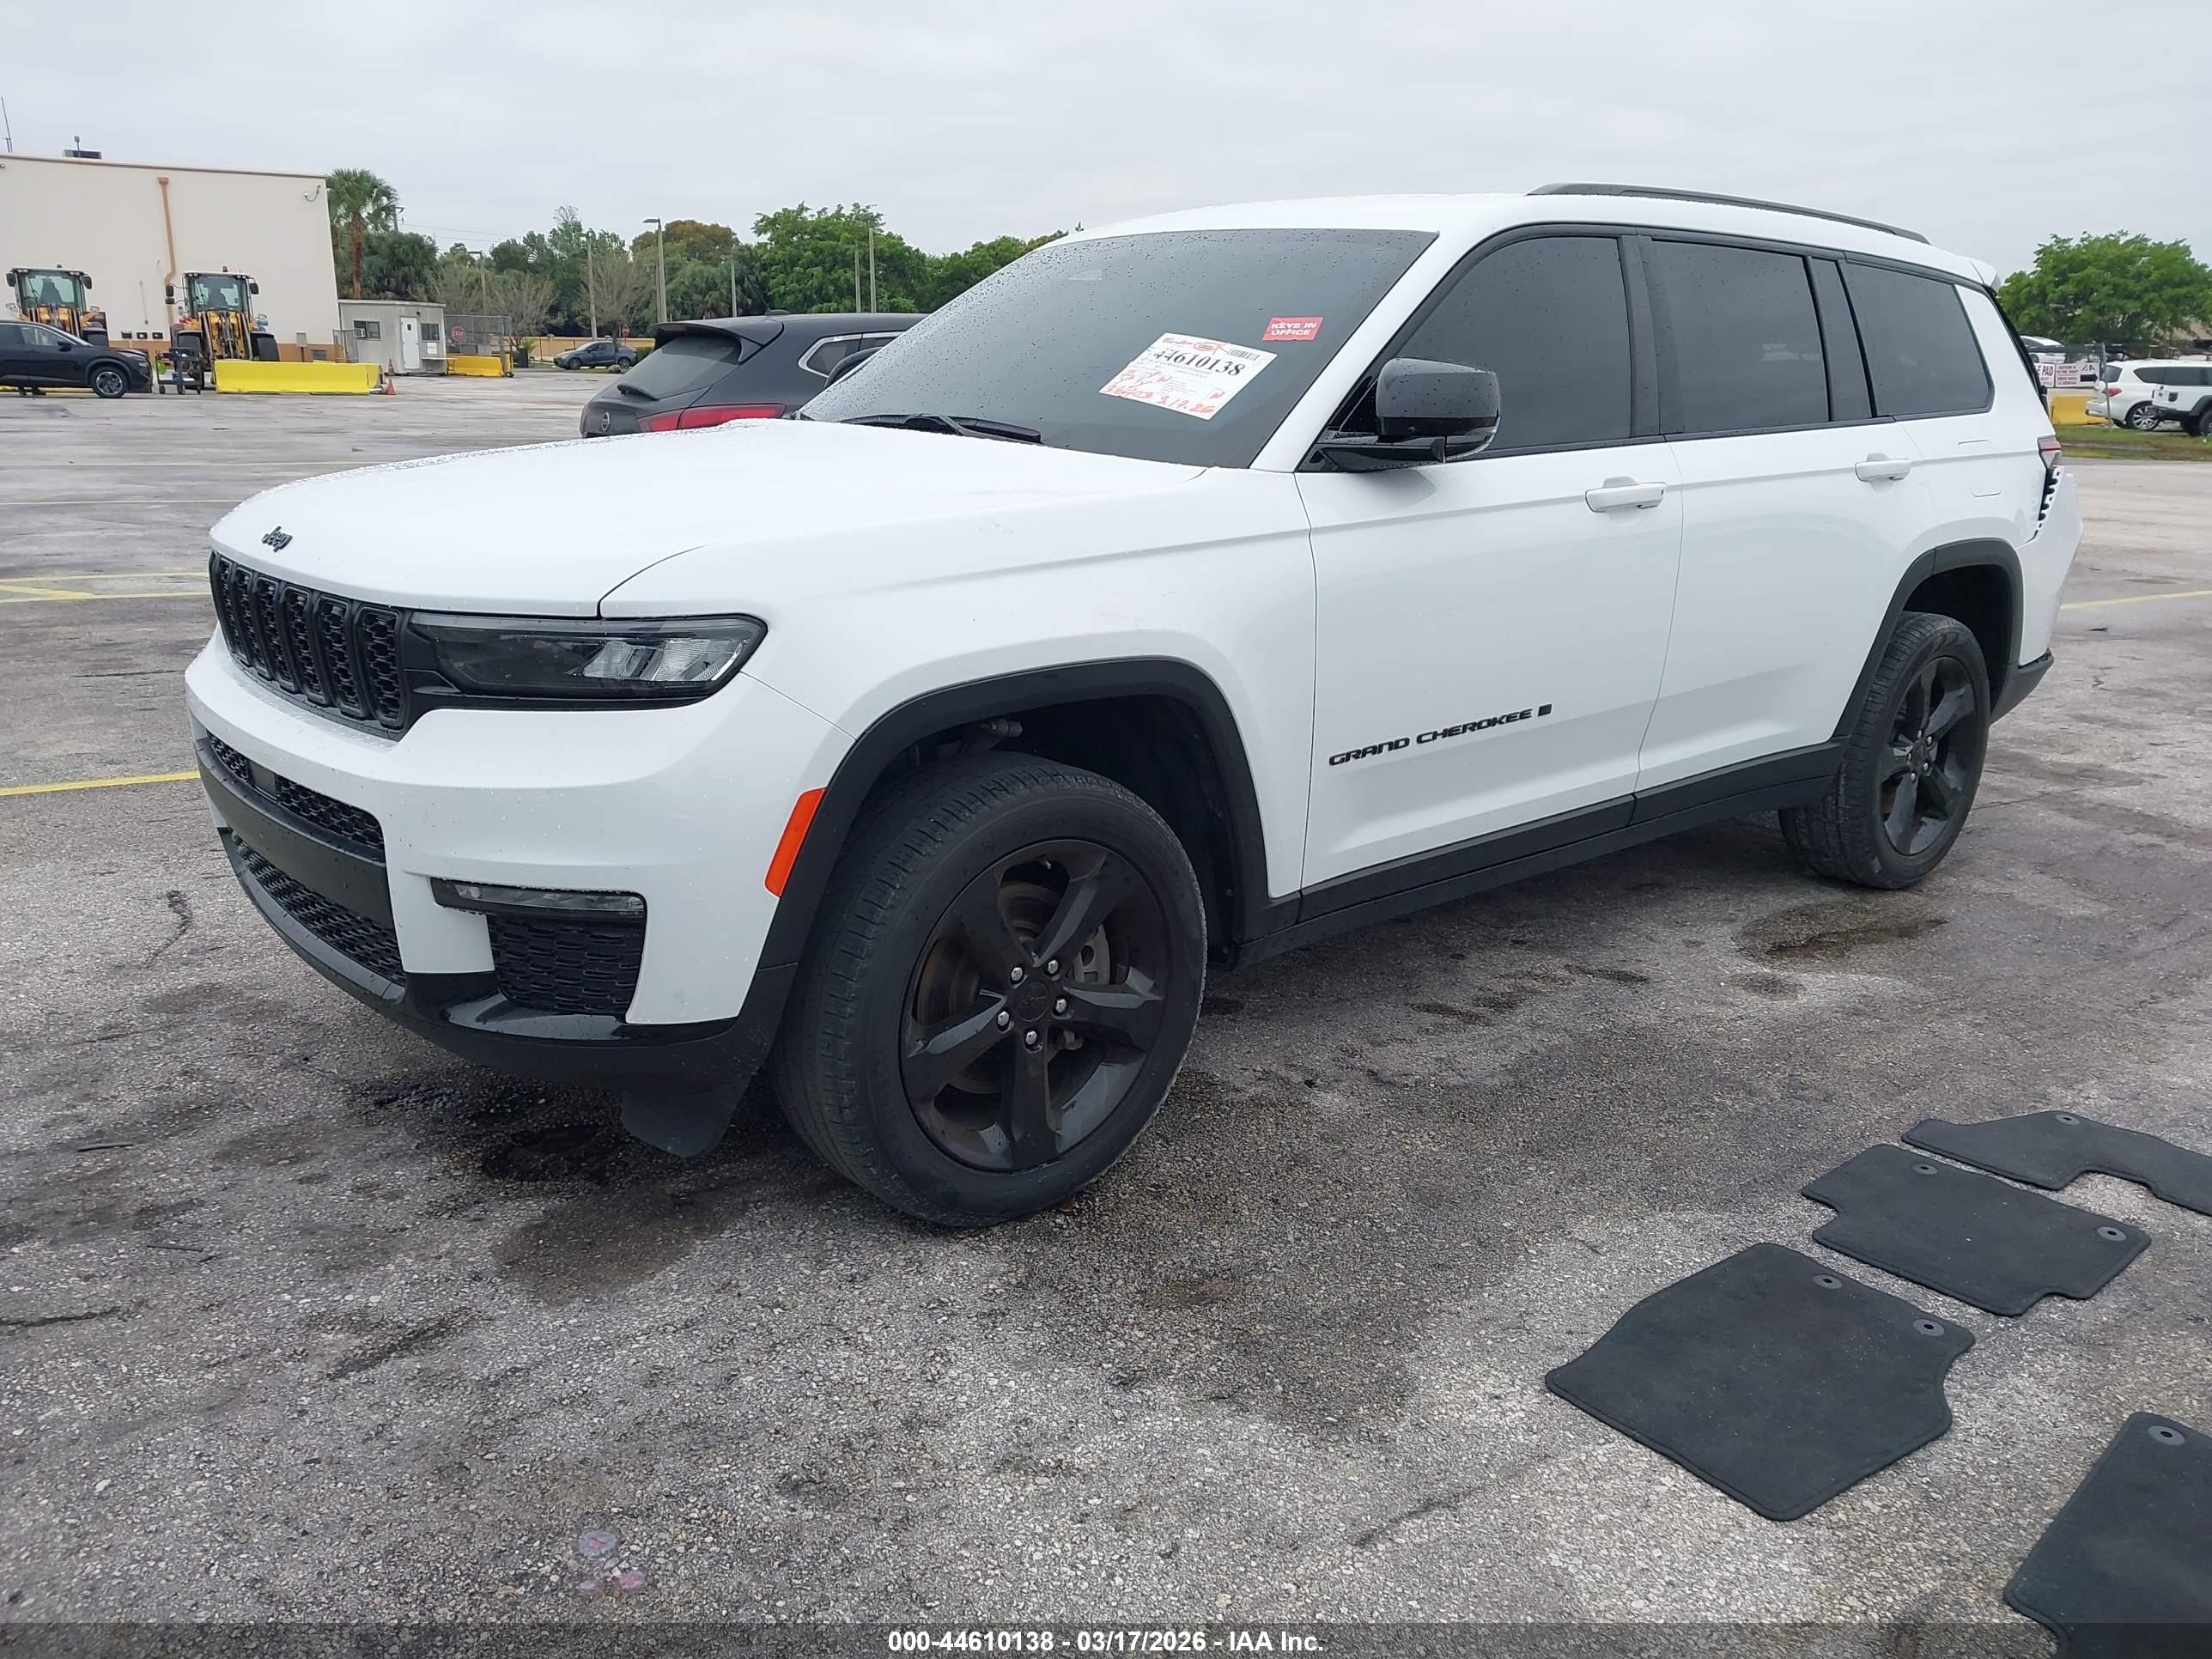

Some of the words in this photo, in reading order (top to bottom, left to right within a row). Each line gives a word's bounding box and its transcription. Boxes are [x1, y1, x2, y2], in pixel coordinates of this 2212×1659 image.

[1153, 349, 1246, 376] 44610138
[2042, 365, 2053, 376] PAD
[262, 526, 293, 552] Jeep
[1329, 738, 1410, 766] GRAND
[1416, 708, 1533, 744] CHEROKEE
